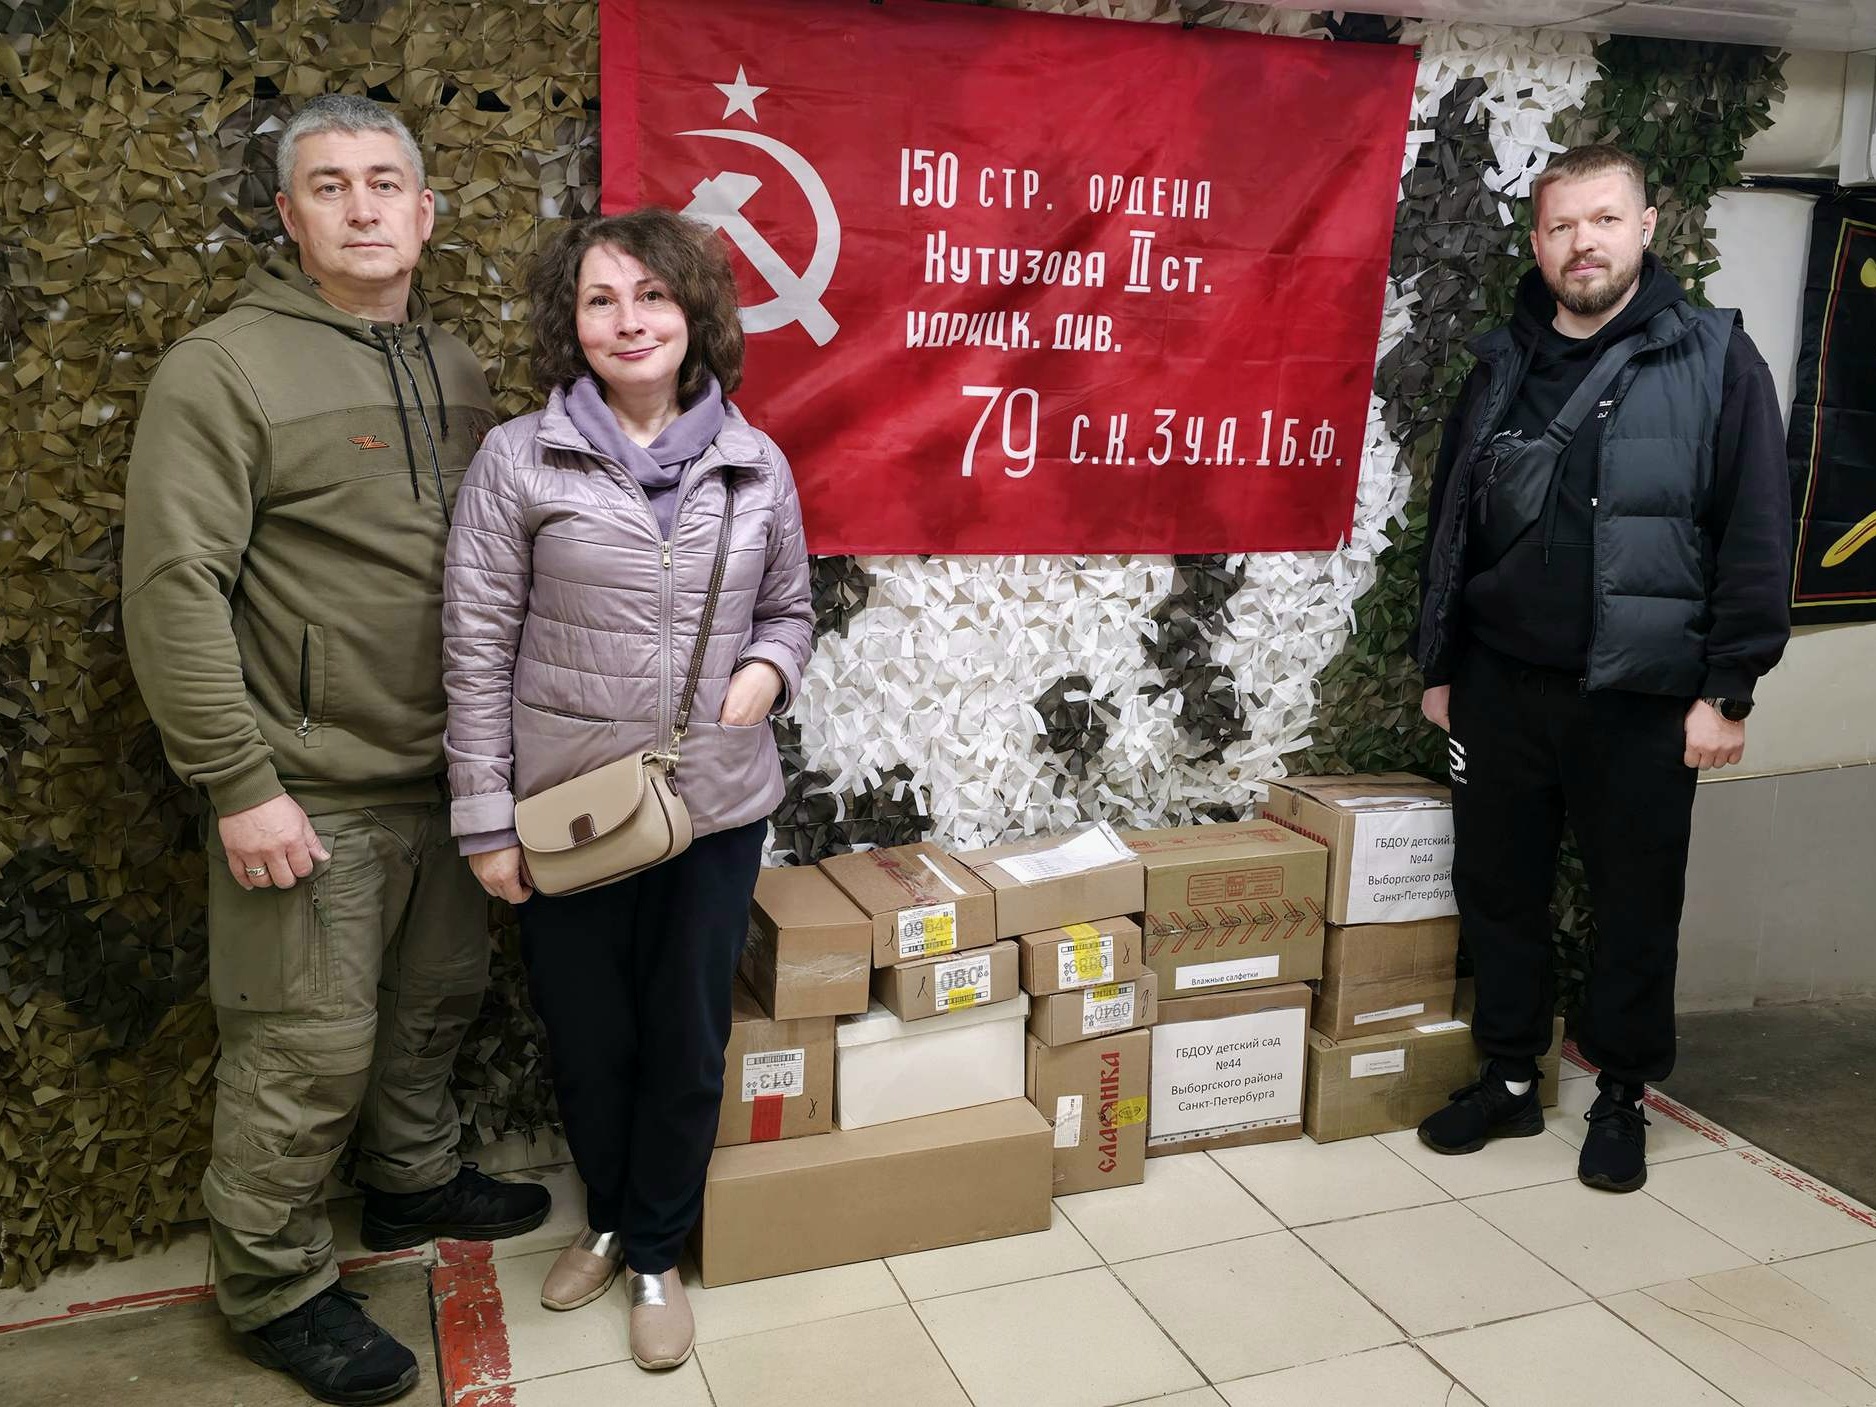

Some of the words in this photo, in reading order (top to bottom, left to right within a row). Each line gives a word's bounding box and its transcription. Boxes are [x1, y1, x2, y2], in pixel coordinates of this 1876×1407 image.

[900, 148, 959, 208] 150
[979, 167, 1053, 211] СТР.
[1088, 174, 1211, 219] ОРДЕНА
[906, 311, 1041, 352] ИДРИЦК.
[1052, 313, 1122, 353] ДИВ.
[961, 385, 1040, 479] 79
[1375, 837, 1410, 849] ГБДОУ
[1411, 834, 1451, 848] детский
[1410, 853, 1433, 865] №44
[1368, 874, 1431, 887] Выборгского
[1433, 870, 1452, 884] рай
[1373, 888, 1456, 903] Санкт-Петербург
[1191, 974, 1225, 986] Влажные
[1226, 971, 1259, 982] салфетки
[1176, 1044, 1214, 1058] ГБДОУ
[1215, 1038, 1260, 1055] детский
[1261, 1036, 1282, 1048] сад
[1215, 1057, 1242, 1071] №44
[1171, 1077, 1242, 1097] Выборгского
[1243, 1071, 1284, 1088] района
[1178, 1090, 1276, 1112] Санкт-Петербурга
